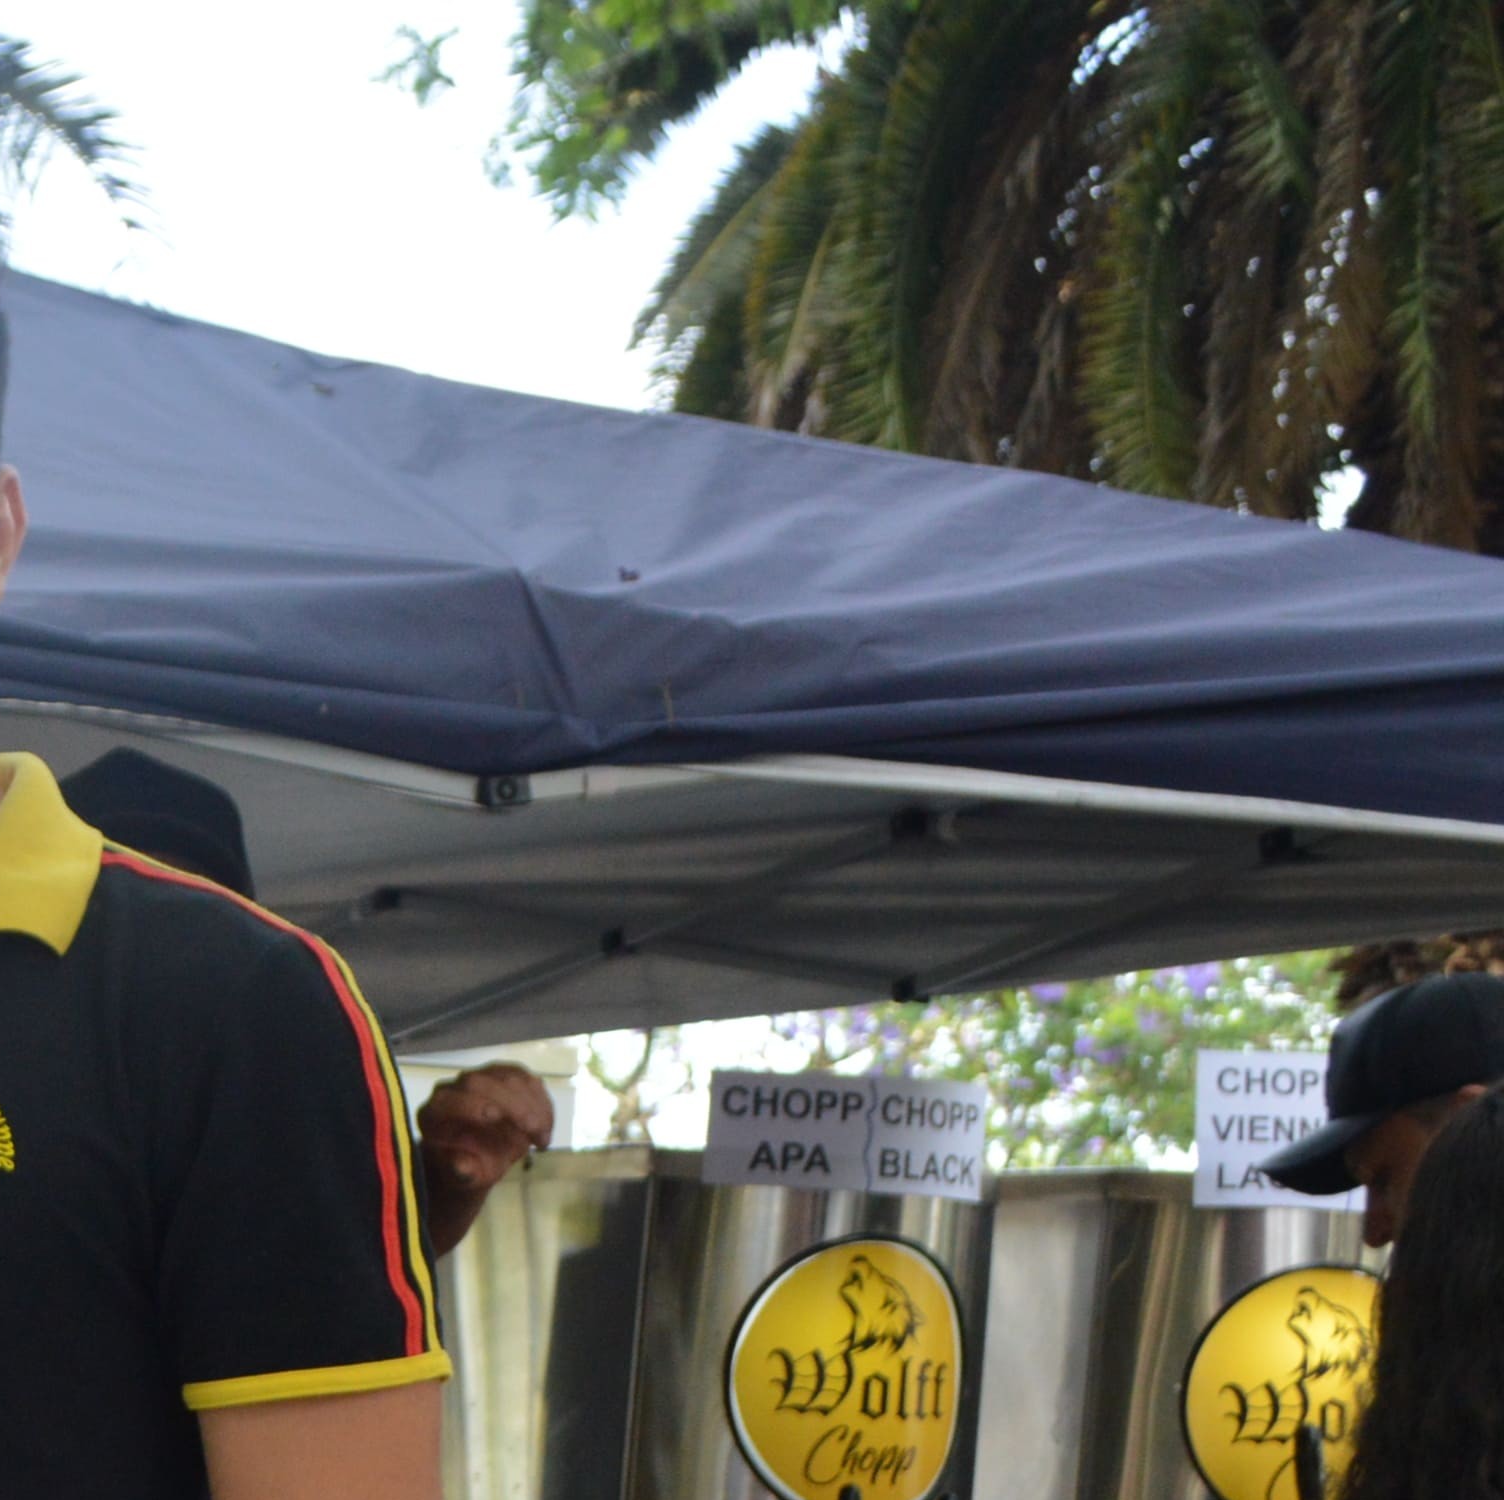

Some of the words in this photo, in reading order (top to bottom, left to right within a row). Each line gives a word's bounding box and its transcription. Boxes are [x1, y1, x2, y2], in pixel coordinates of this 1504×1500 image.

[1217, 1066, 1320, 1096] CHOP
[721, 1085, 864, 1122] CHOPP
[881, 1093, 979, 1133] CHOPP
[748, 1140, 831, 1174] APA
[878, 1147, 976, 1188] BLACK
[767, 1347, 948, 1421] Wolff
[803, 1424, 917, 1487] Chopp
